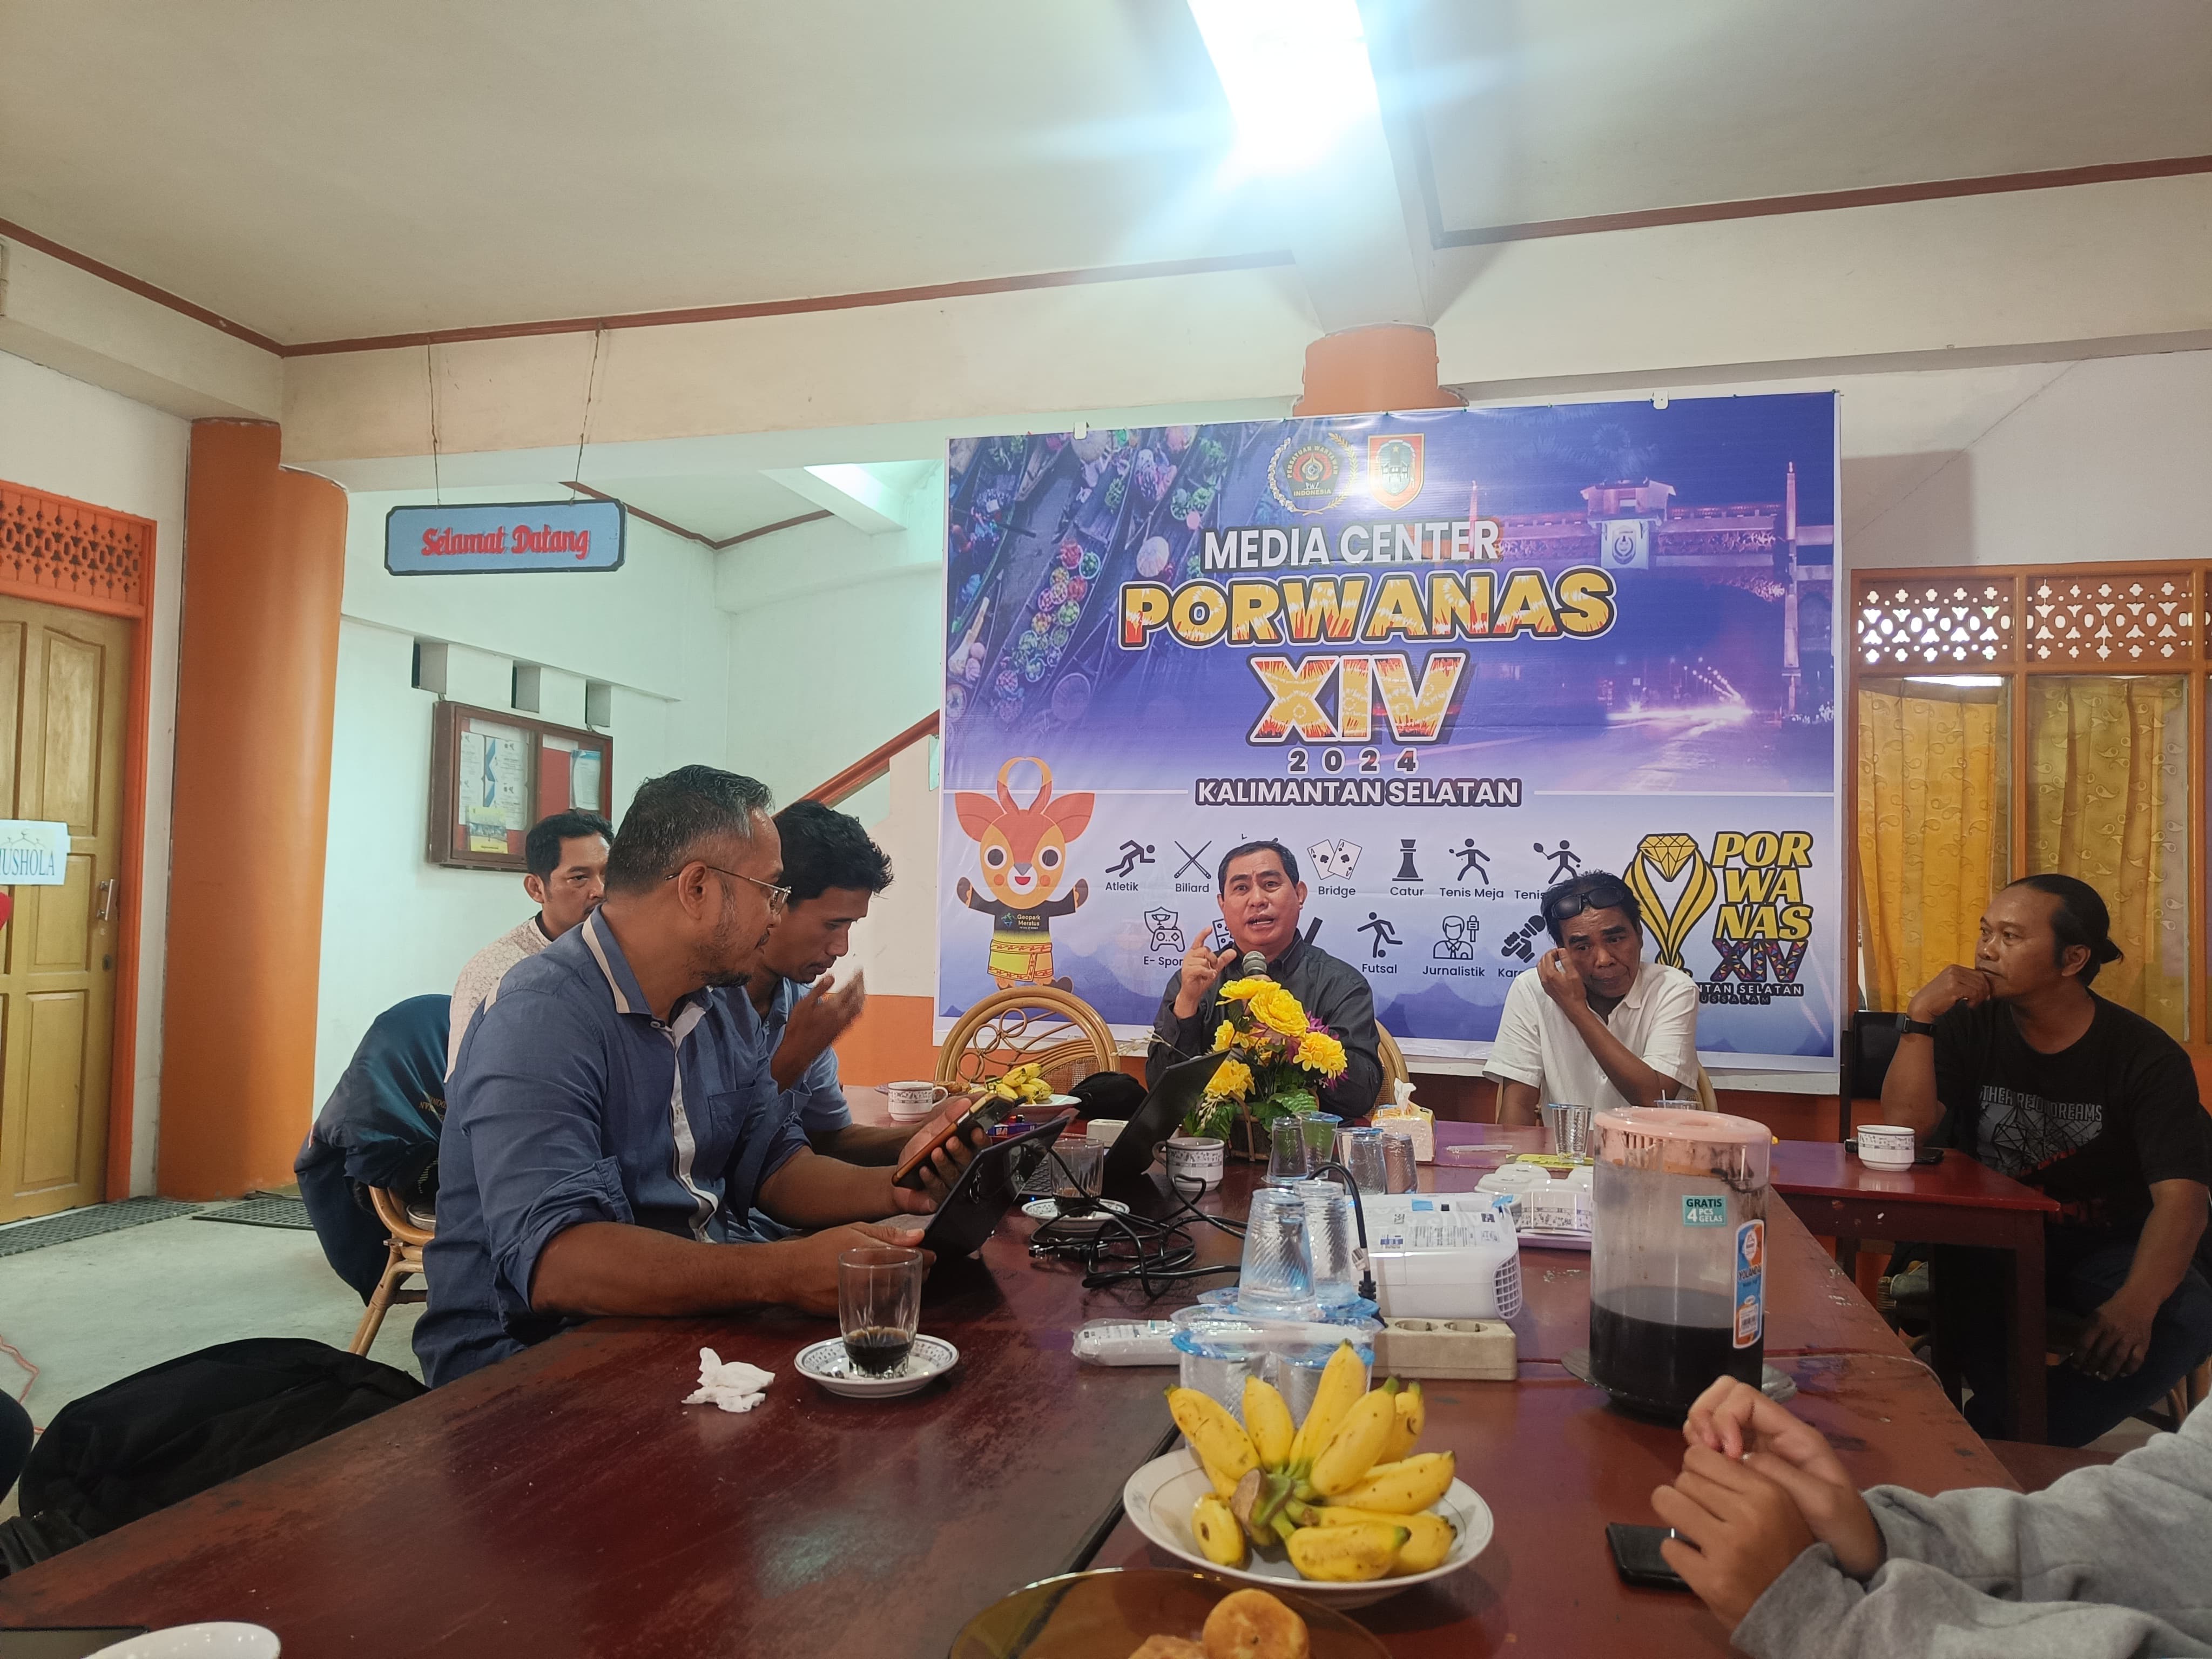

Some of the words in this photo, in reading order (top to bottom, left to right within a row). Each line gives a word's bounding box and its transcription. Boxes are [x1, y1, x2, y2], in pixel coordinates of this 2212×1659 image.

[1287, 446, 1312, 478] PERSATUAN
[1314, 445, 1338, 475] WARTAWAN
[421, 525, 507, 556] Selamat
[511, 524, 590, 560] Datang
[1204, 527, 1330, 570] MEDIA
[1340, 520, 1500, 563] CENTER
[1121, 568, 1613, 647] PORWANAS
[1249, 652, 1467, 743] XIV
[1198, 781, 1381, 804] KALIMANTAN
[1388, 781, 1519, 804] SELATAN
[1711, 832, 1812, 867] POR
[0, 848, 55, 875] USHOLA
[1105, 882, 1138, 891] Atletik
[1175, 882, 1209, 893] Biliard
[1318, 886, 1356, 898] Bridge
[1390, 887, 1424, 896] Catur
[1440, 887, 1471, 897] Tenis
[1474, 888, 1504, 900] Meja
[1724, 869, 1802, 903] WA
[1715, 905, 1812, 940] NAS
[1144, 956, 1155, 965] E-
[1158, 956, 1183, 968] Spor
[1362, 964, 1397, 973] Futsal
[1710, 939, 1808, 982] XIV
[1422, 966, 1485, 977] Jurnalistik
[1739, 985, 1802, 995] SELATAN
[2052, 1102, 2102, 1122] DREAMS
[1686, 1198, 1722, 1208] GRATIS
[1687, 1208, 1698, 1222] 4
